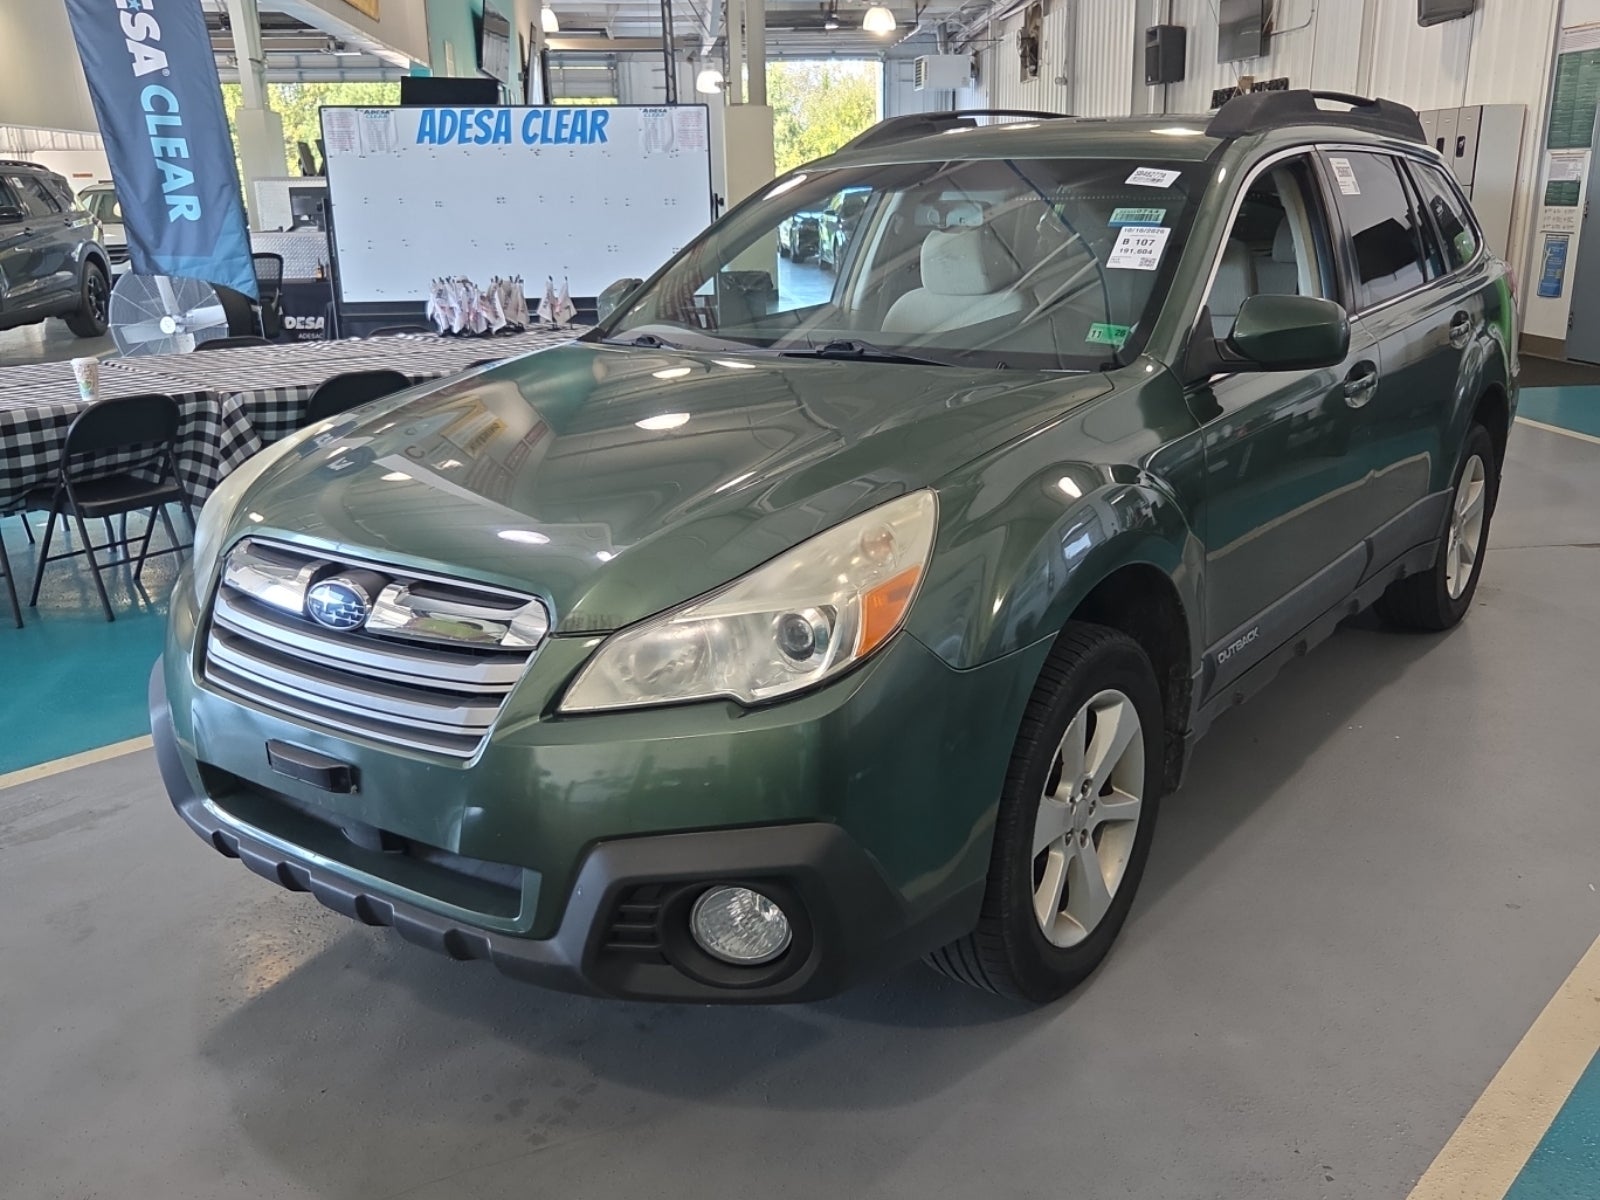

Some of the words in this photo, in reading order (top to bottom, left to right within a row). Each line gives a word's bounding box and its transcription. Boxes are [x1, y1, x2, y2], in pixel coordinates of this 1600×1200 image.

[416, 109, 512, 145] ADESA
[521, 109, 609, 145] CLEAR
[140, 84, 201, 223] CLEAR
[1122, 238, 1130, 246] B
[1136, 239, 1156, 247] 107
[284, 316, 325, 330] DESA
[1091, 330, 1102, 339] 11
[1218, 626, 1260, 664] OUTBACK
